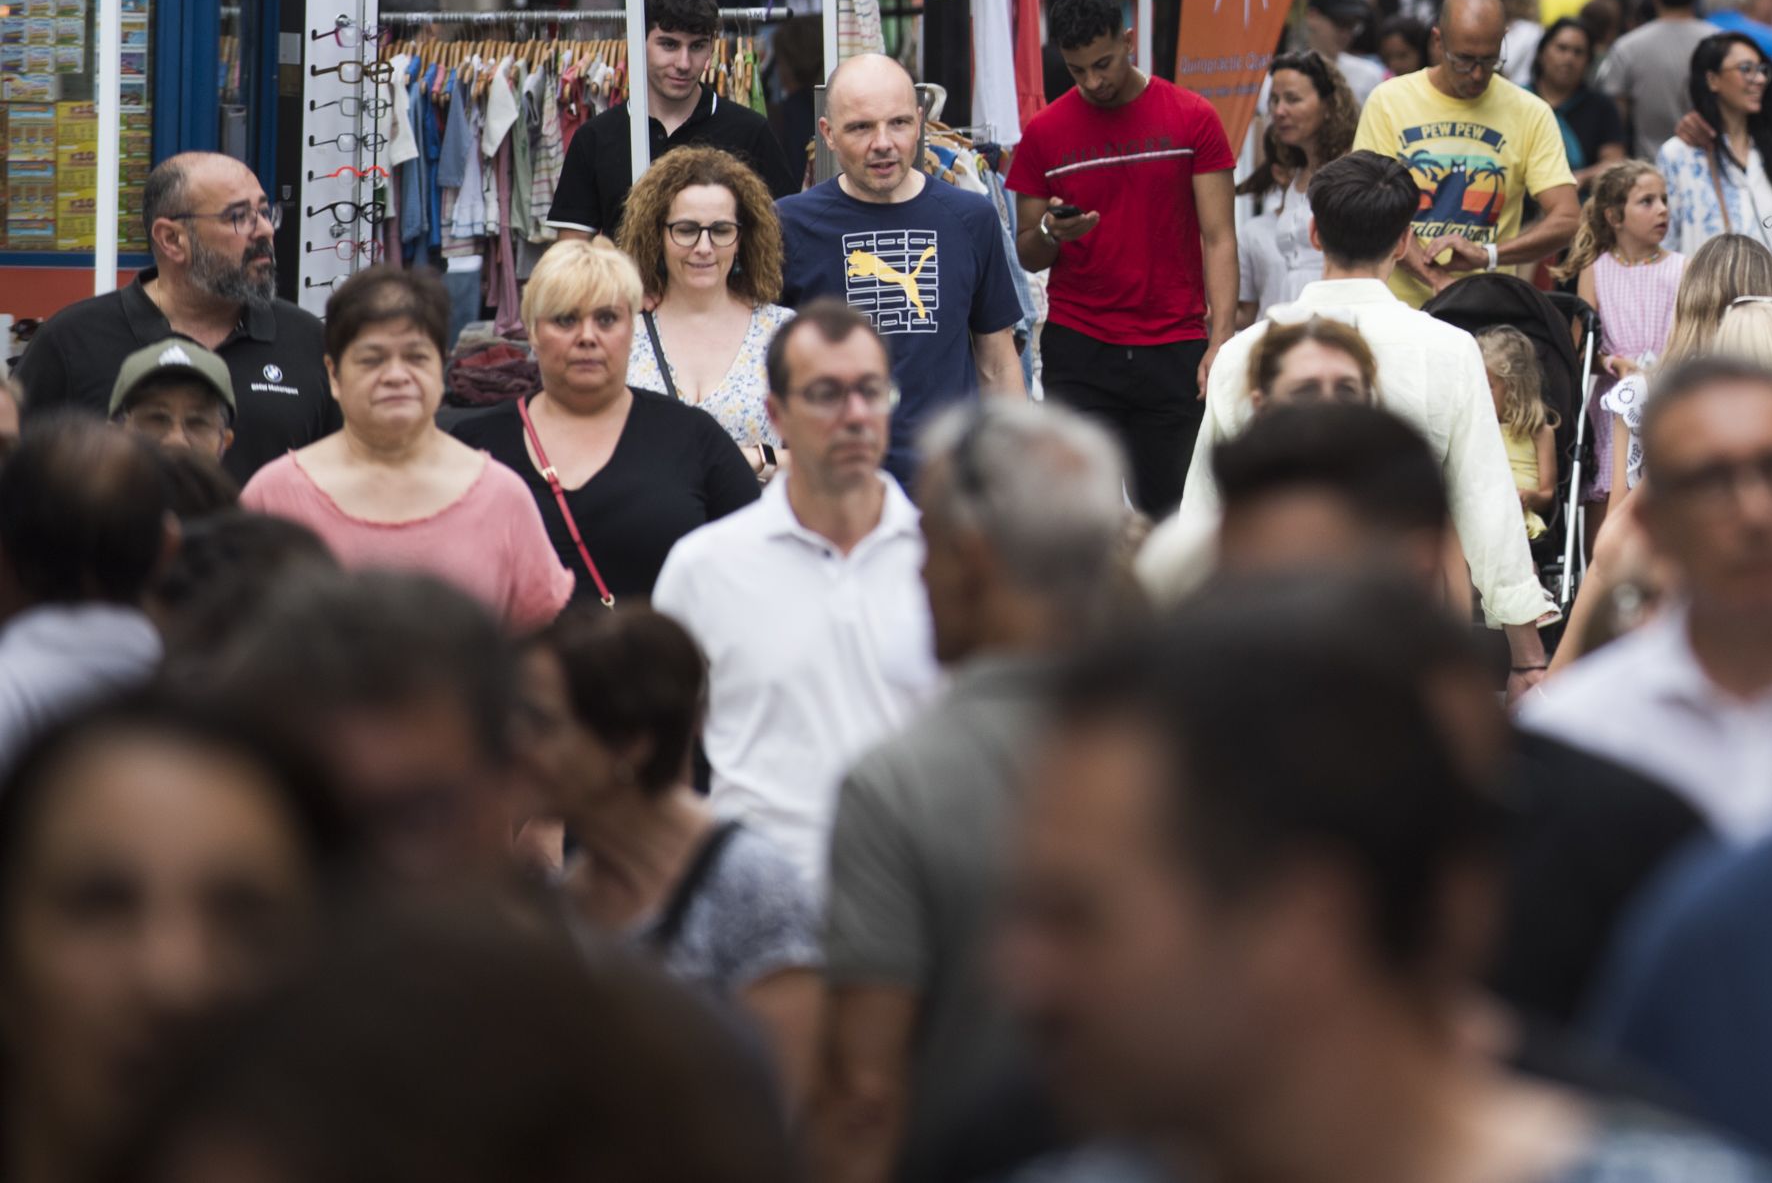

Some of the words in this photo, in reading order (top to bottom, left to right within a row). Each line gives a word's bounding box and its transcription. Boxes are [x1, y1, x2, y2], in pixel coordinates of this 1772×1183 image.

[1420, 122, 1453, 138] PEW
[1455, 122, 1487, 138] PEW
[251, 382, 268, 391] BMW
